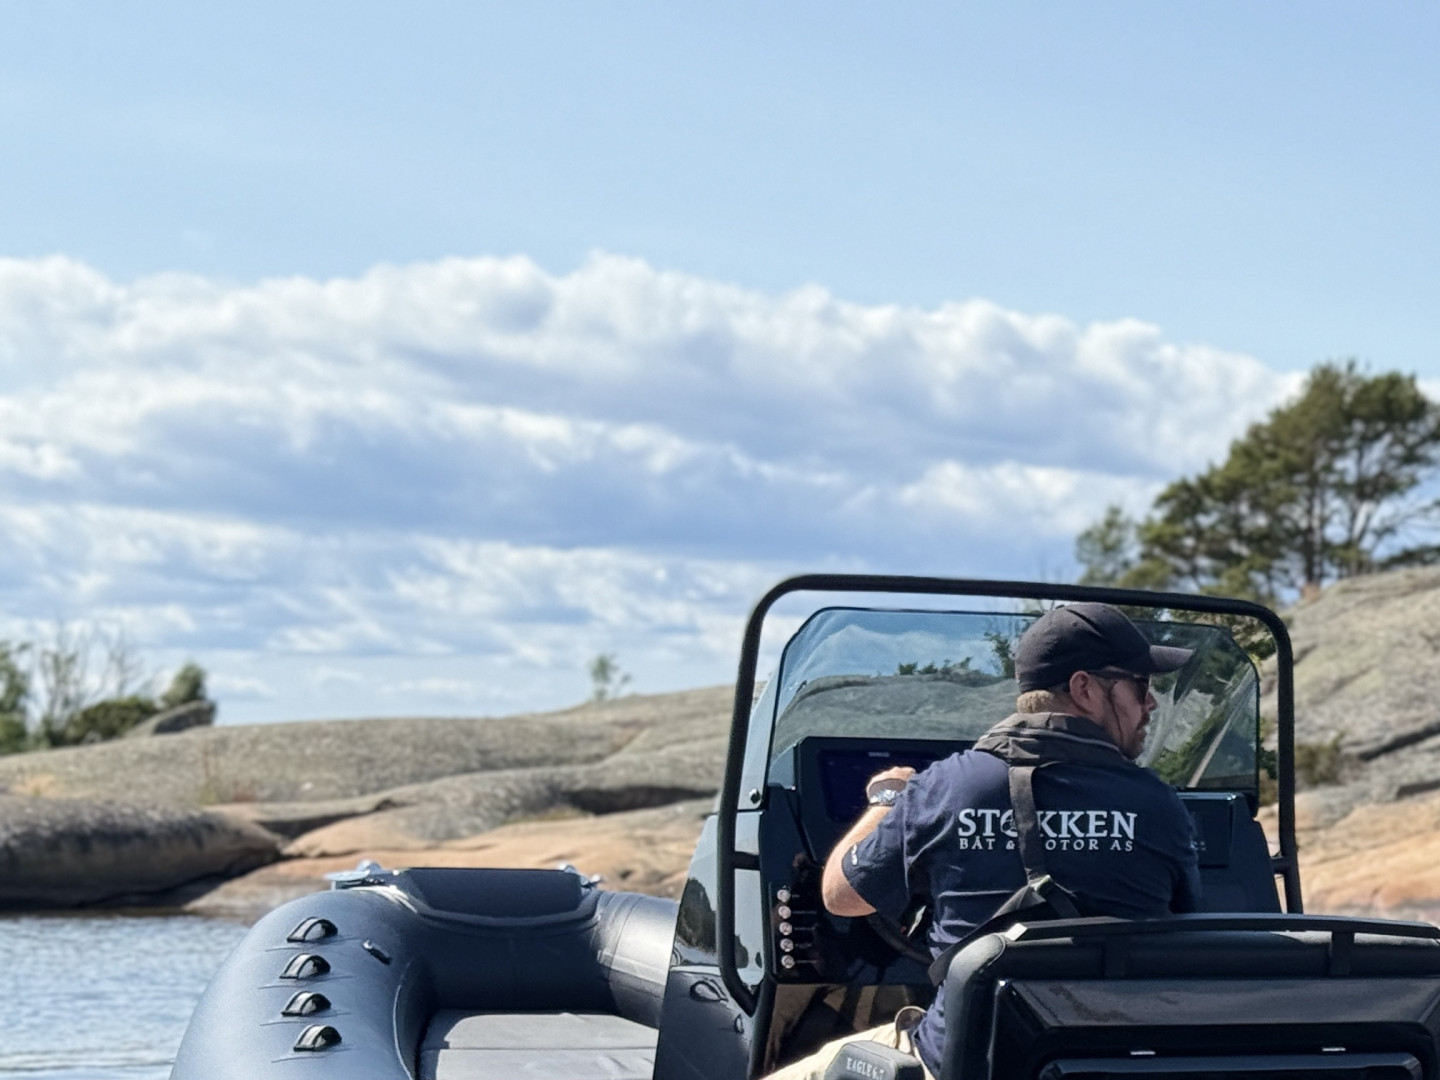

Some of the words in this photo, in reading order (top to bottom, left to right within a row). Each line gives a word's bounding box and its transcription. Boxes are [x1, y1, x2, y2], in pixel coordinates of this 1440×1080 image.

[959, 835, 996, 850] BÅT
[1005, 840, 1016, 850] &
[1044, 838, 1100, 851] OTOR
[1110, 839, 1133, 852] AS
[846, 1057, 872, 1077] EAGLE
